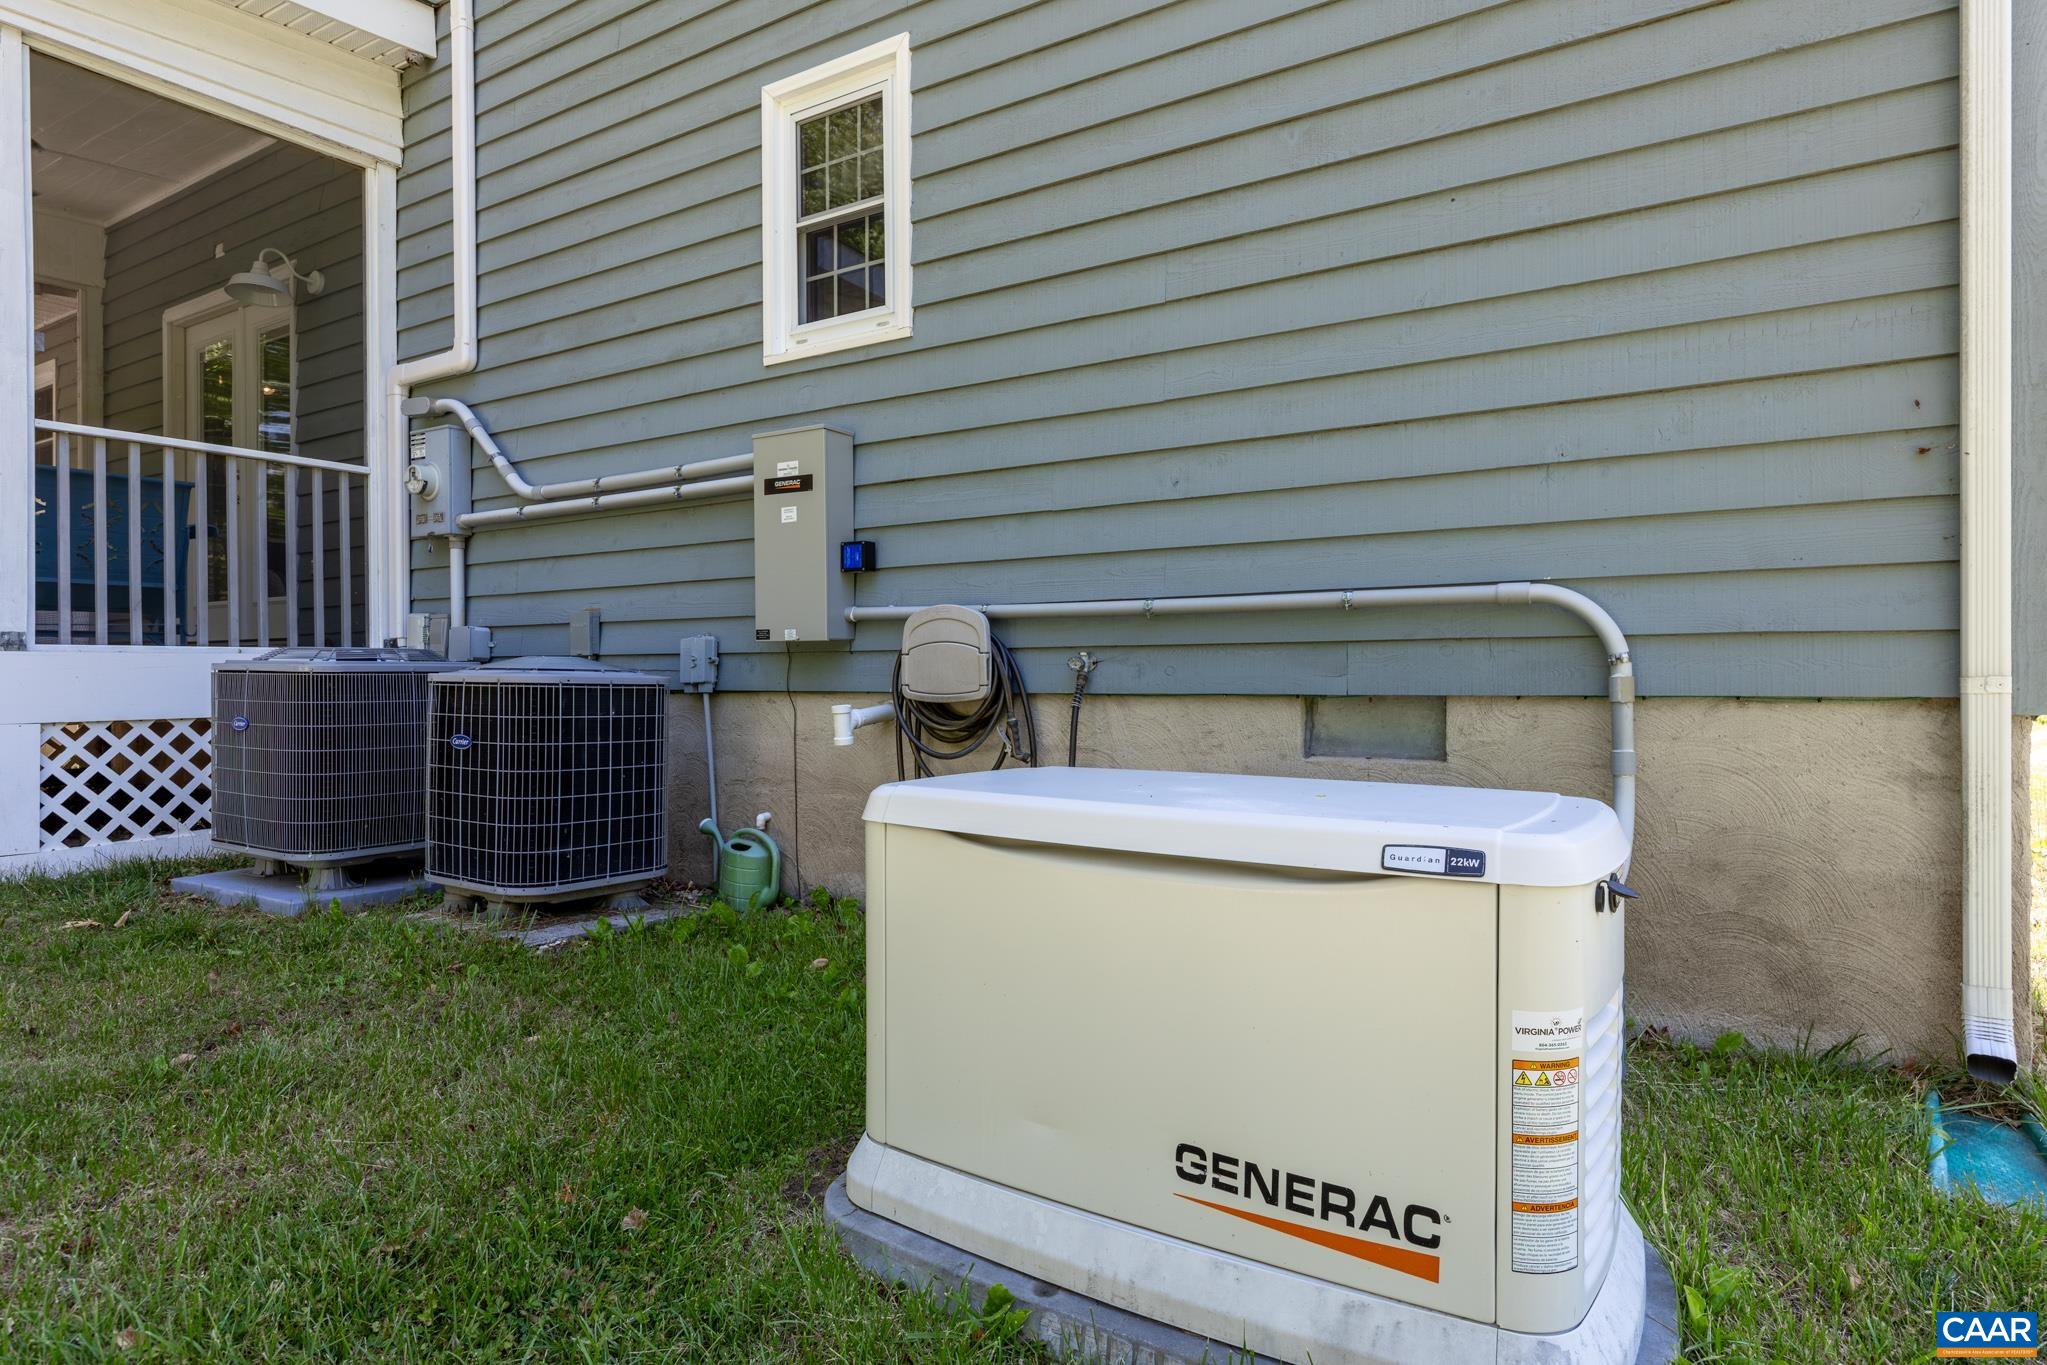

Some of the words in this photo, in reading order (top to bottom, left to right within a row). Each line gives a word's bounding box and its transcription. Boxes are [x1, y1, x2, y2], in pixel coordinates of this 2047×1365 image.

[774, 479, 801, 487] GENERAC
[1389, 853, 1441, 864] Guardian
[1450, 857, 1480, 868] 22kW
[1515, 1027, 1554, 1036] VIRGINIA
[1558, 1024, 1582, 1035] POWER
[1540, 1061, 1570, 1069] WARNING
[1175, 1142, 1441, 1250] GENERAC
